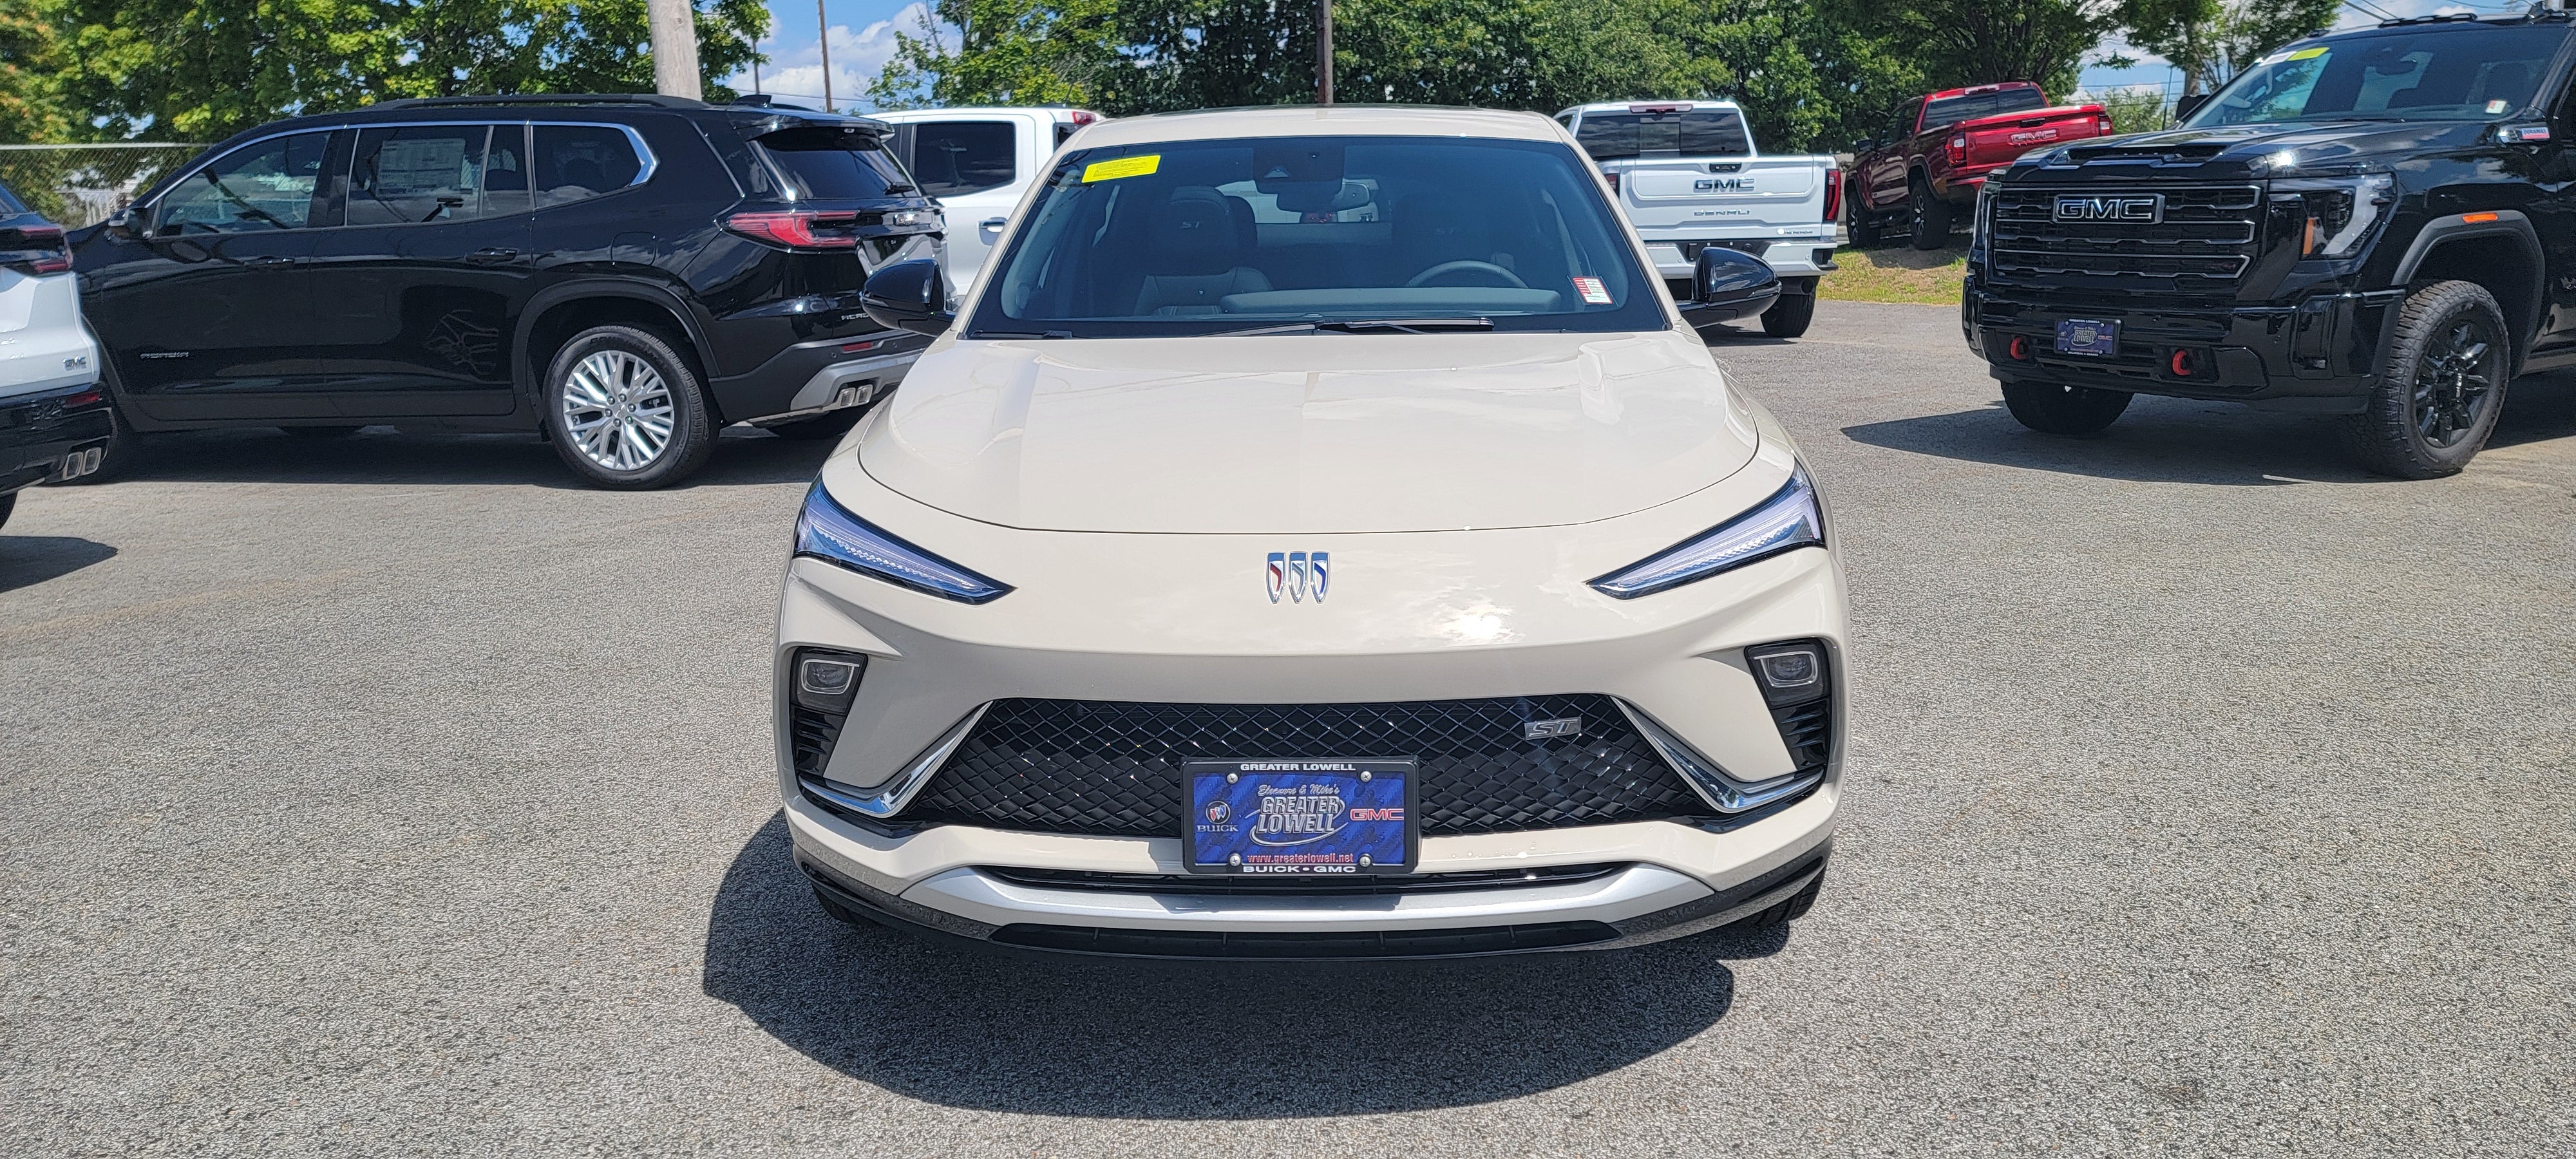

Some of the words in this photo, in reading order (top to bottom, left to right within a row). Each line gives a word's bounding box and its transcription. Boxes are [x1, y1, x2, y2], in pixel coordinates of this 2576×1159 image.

[2010, 130, 2057, 144] GMC
[1694, 178, 1756, 193] GMC
[2057, 198, 2154, 220] GMC
[841, 312, 869, 321] ACAD
[1528, 719, 1578, 737] ST
[1298, 784, 1307, 795] &
[1309, 784, 1340, 795] Mike's
[1260, 796, 1340, 815] GREATER
[1350, 809, 1404, 821] GMC
[1256, 813, 1335, 834] LOWELL
[1247, 853, 1354, 863] www.greaterlowell.net
